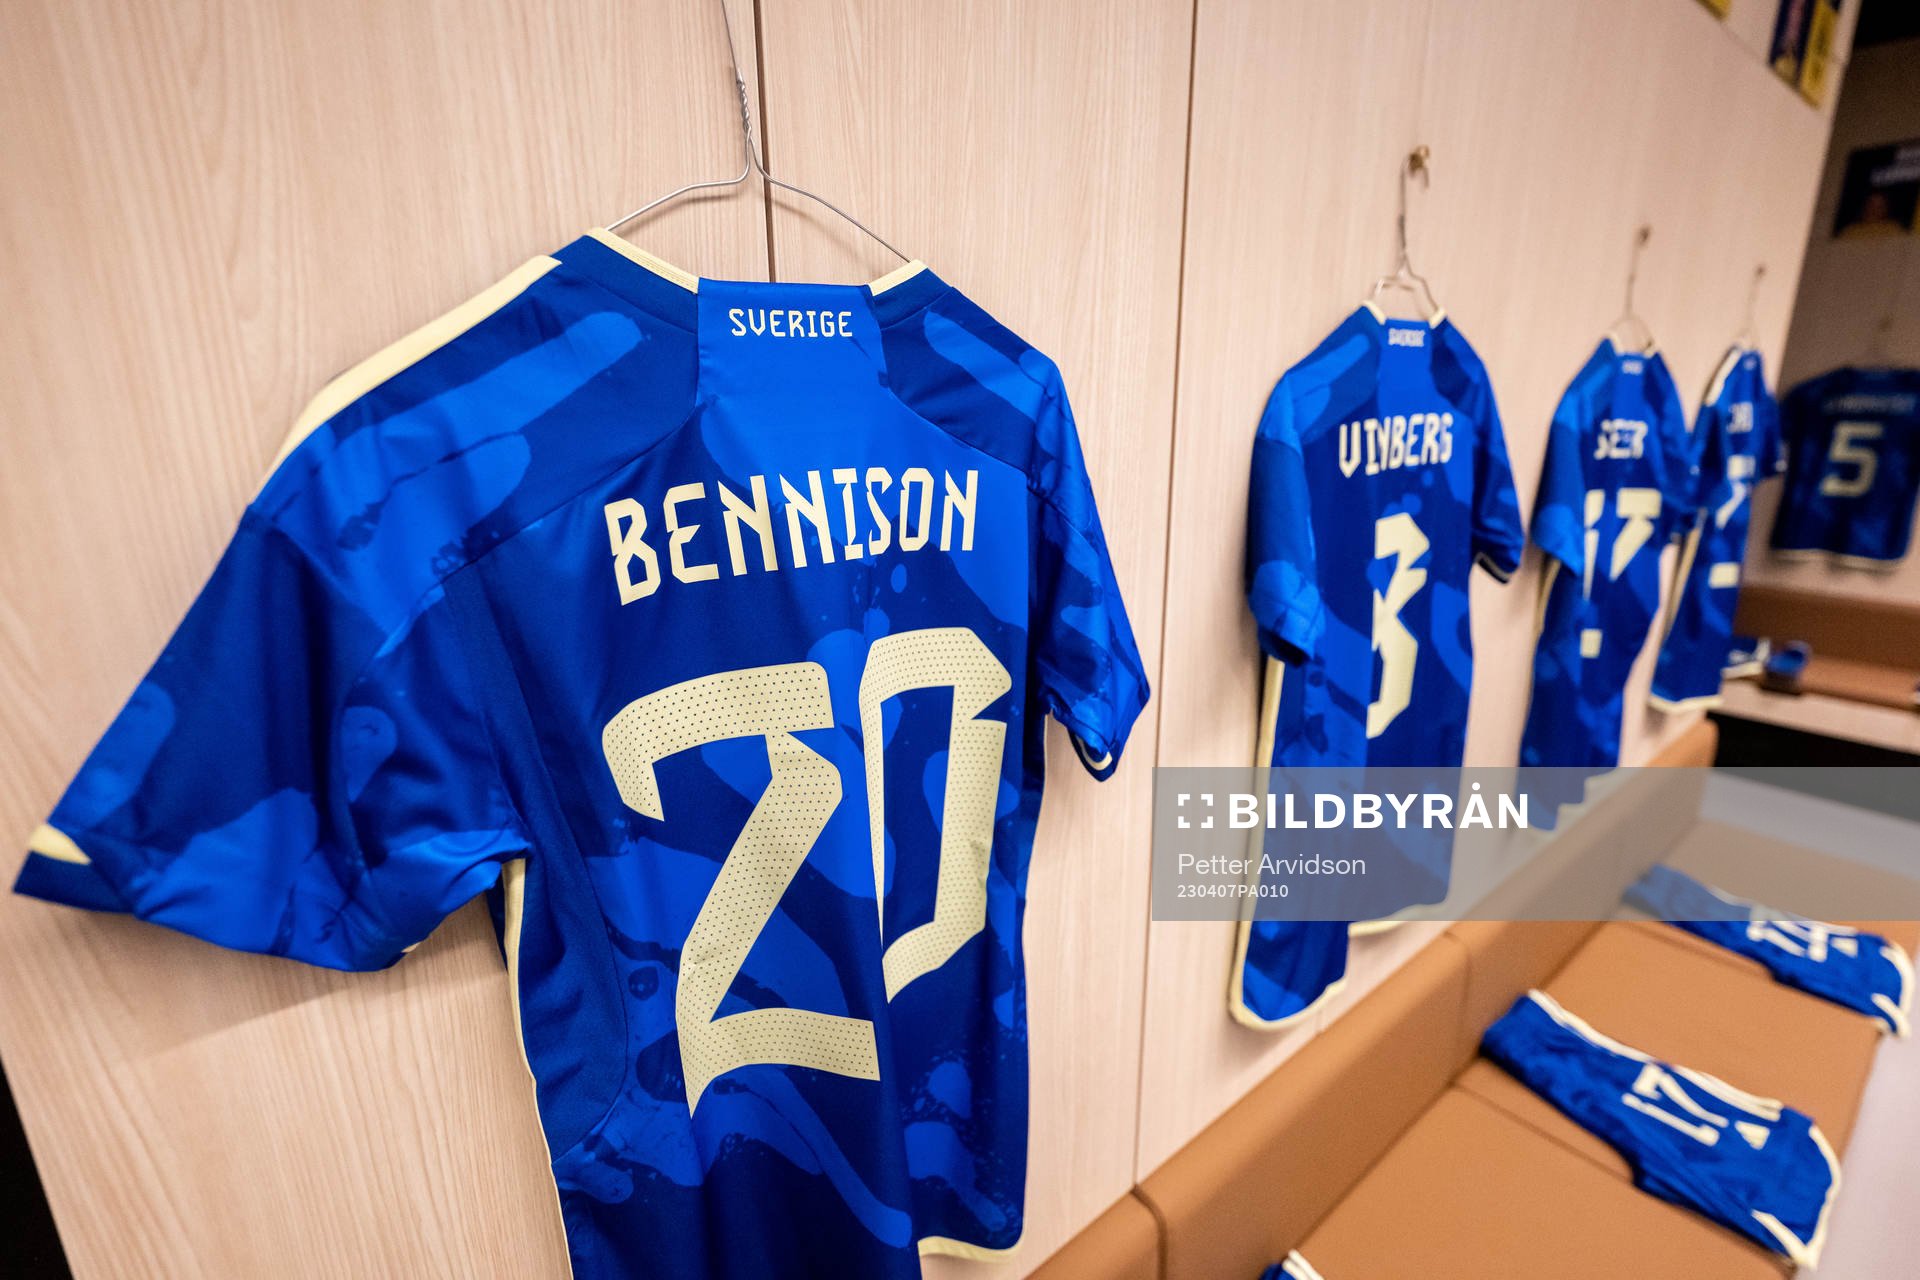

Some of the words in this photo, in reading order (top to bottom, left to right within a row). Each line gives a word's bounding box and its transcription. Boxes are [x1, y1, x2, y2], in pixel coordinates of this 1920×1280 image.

[728, 308, 853, 337] SVERIGE
[1821, 422, 1883, 497] 5
[603, 467, 979, 606] BENNISON
[602, 627, 1012, 1119] 20
